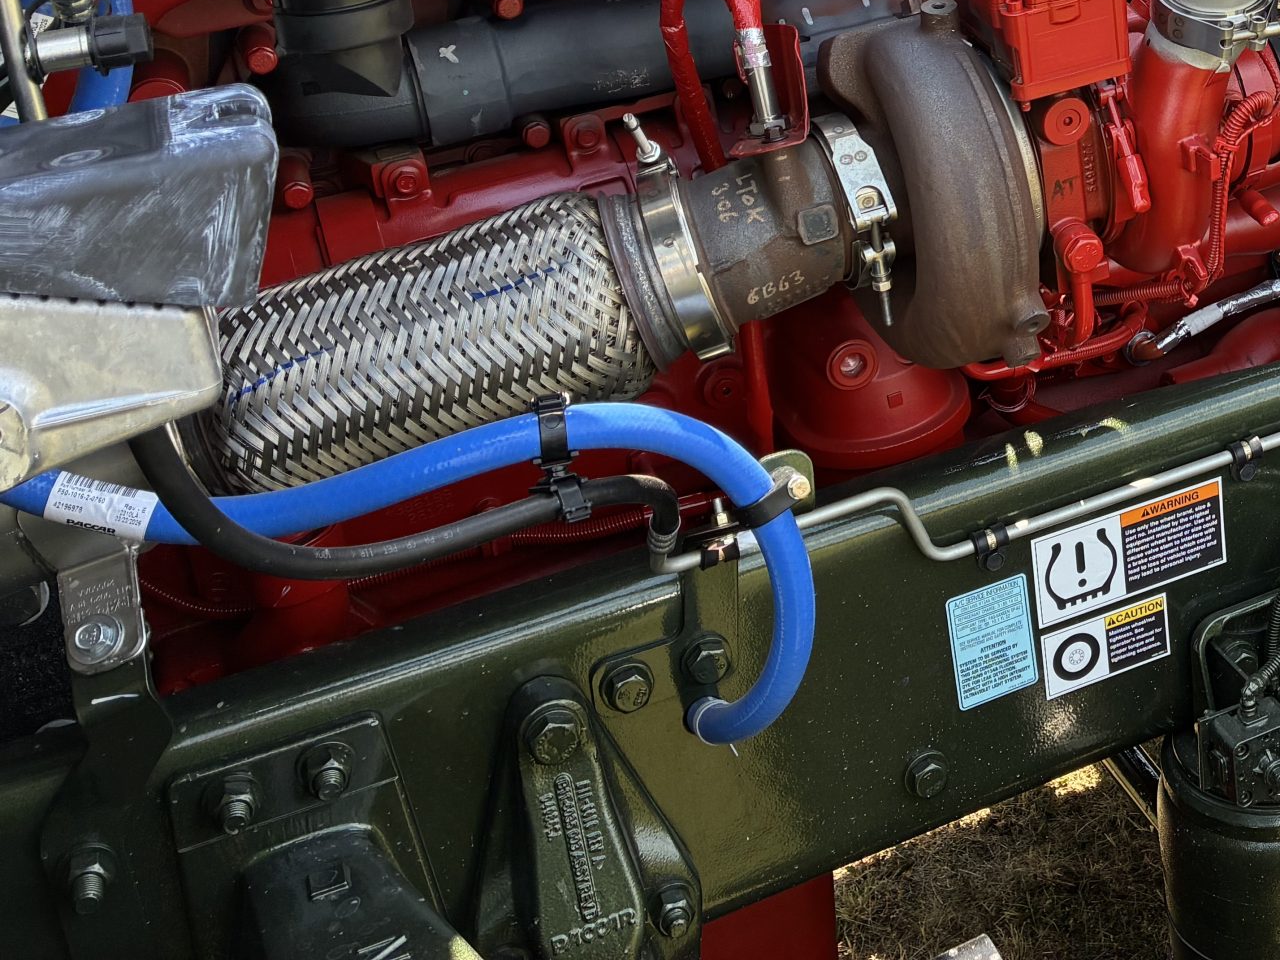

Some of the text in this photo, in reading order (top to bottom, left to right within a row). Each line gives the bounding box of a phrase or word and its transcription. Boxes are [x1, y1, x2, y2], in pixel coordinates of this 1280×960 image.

[1150, 490, 1198, 514] WARNING
[65, 518, 116, 535] PACCAR
[1115, 600, 1162, 622] CAUTION
